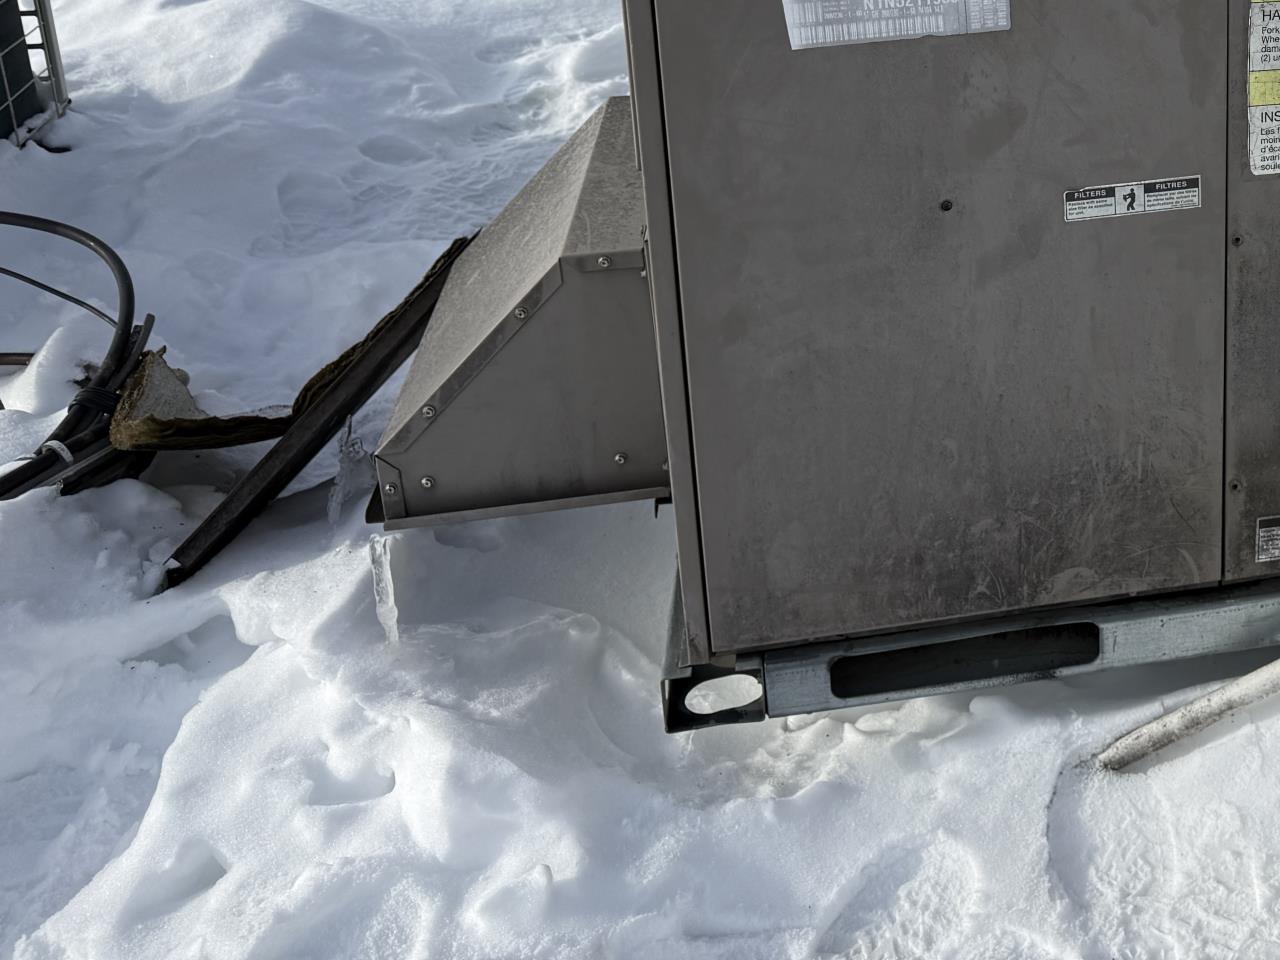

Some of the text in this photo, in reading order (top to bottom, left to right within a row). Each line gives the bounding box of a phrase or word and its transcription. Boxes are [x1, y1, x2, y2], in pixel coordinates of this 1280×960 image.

[1260, 54, 1270, 63] (2)
[1260, 127, 1274, 135] Les
[1155, 181, 1187, 190] FILTRES
[1074, 190, 1106, 199] FILTERS
